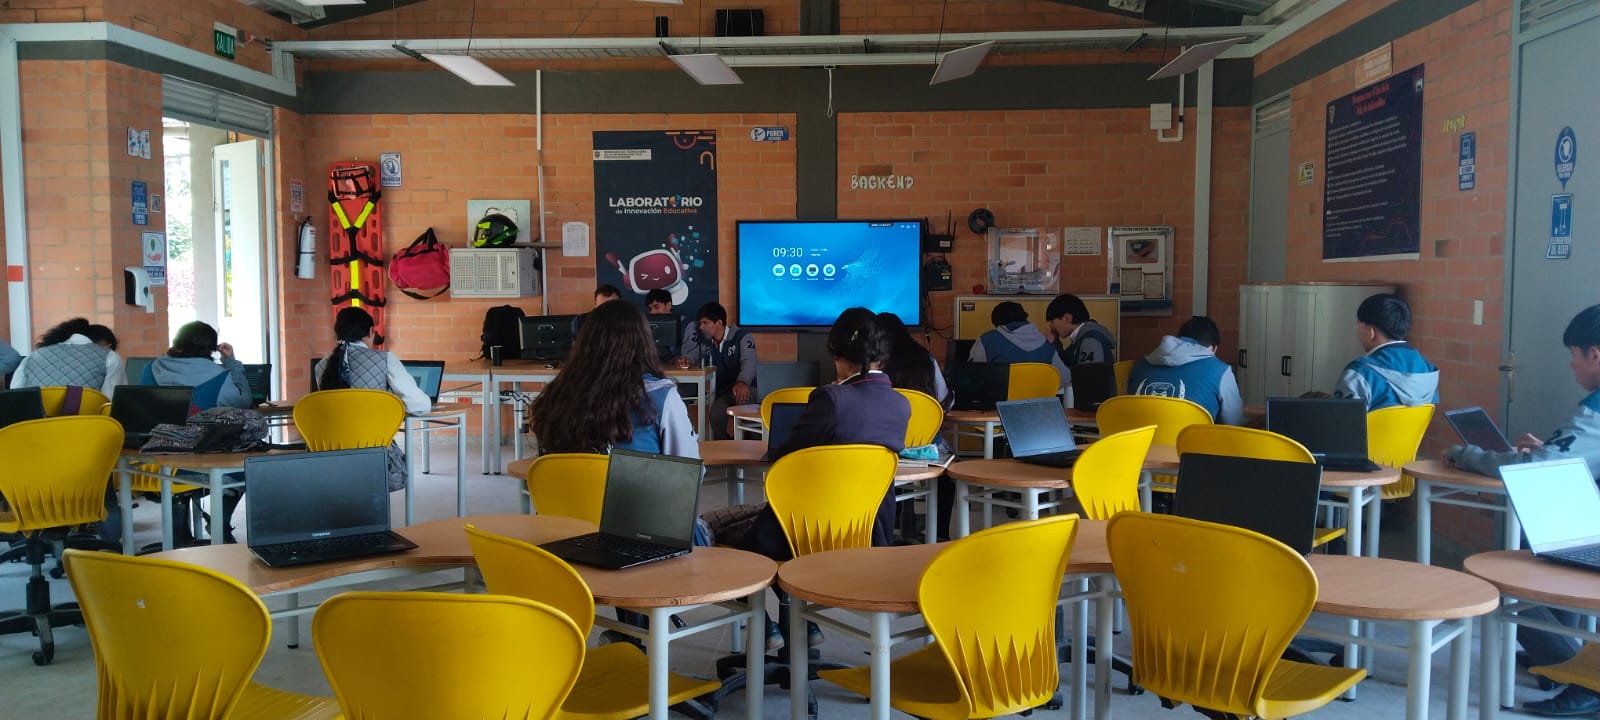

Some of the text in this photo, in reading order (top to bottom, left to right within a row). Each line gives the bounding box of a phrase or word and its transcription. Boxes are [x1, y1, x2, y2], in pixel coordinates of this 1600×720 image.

[216, 32, 235, 56] SALIDA
[851, 175, 914, 190] BACKEND
[609, 195, 703, 207] LABORATORIO
[772, 247, 803, 258] 09:30
[1080, 351, 1095, 362] 24
[1544, 429, 1577, 453] 24
